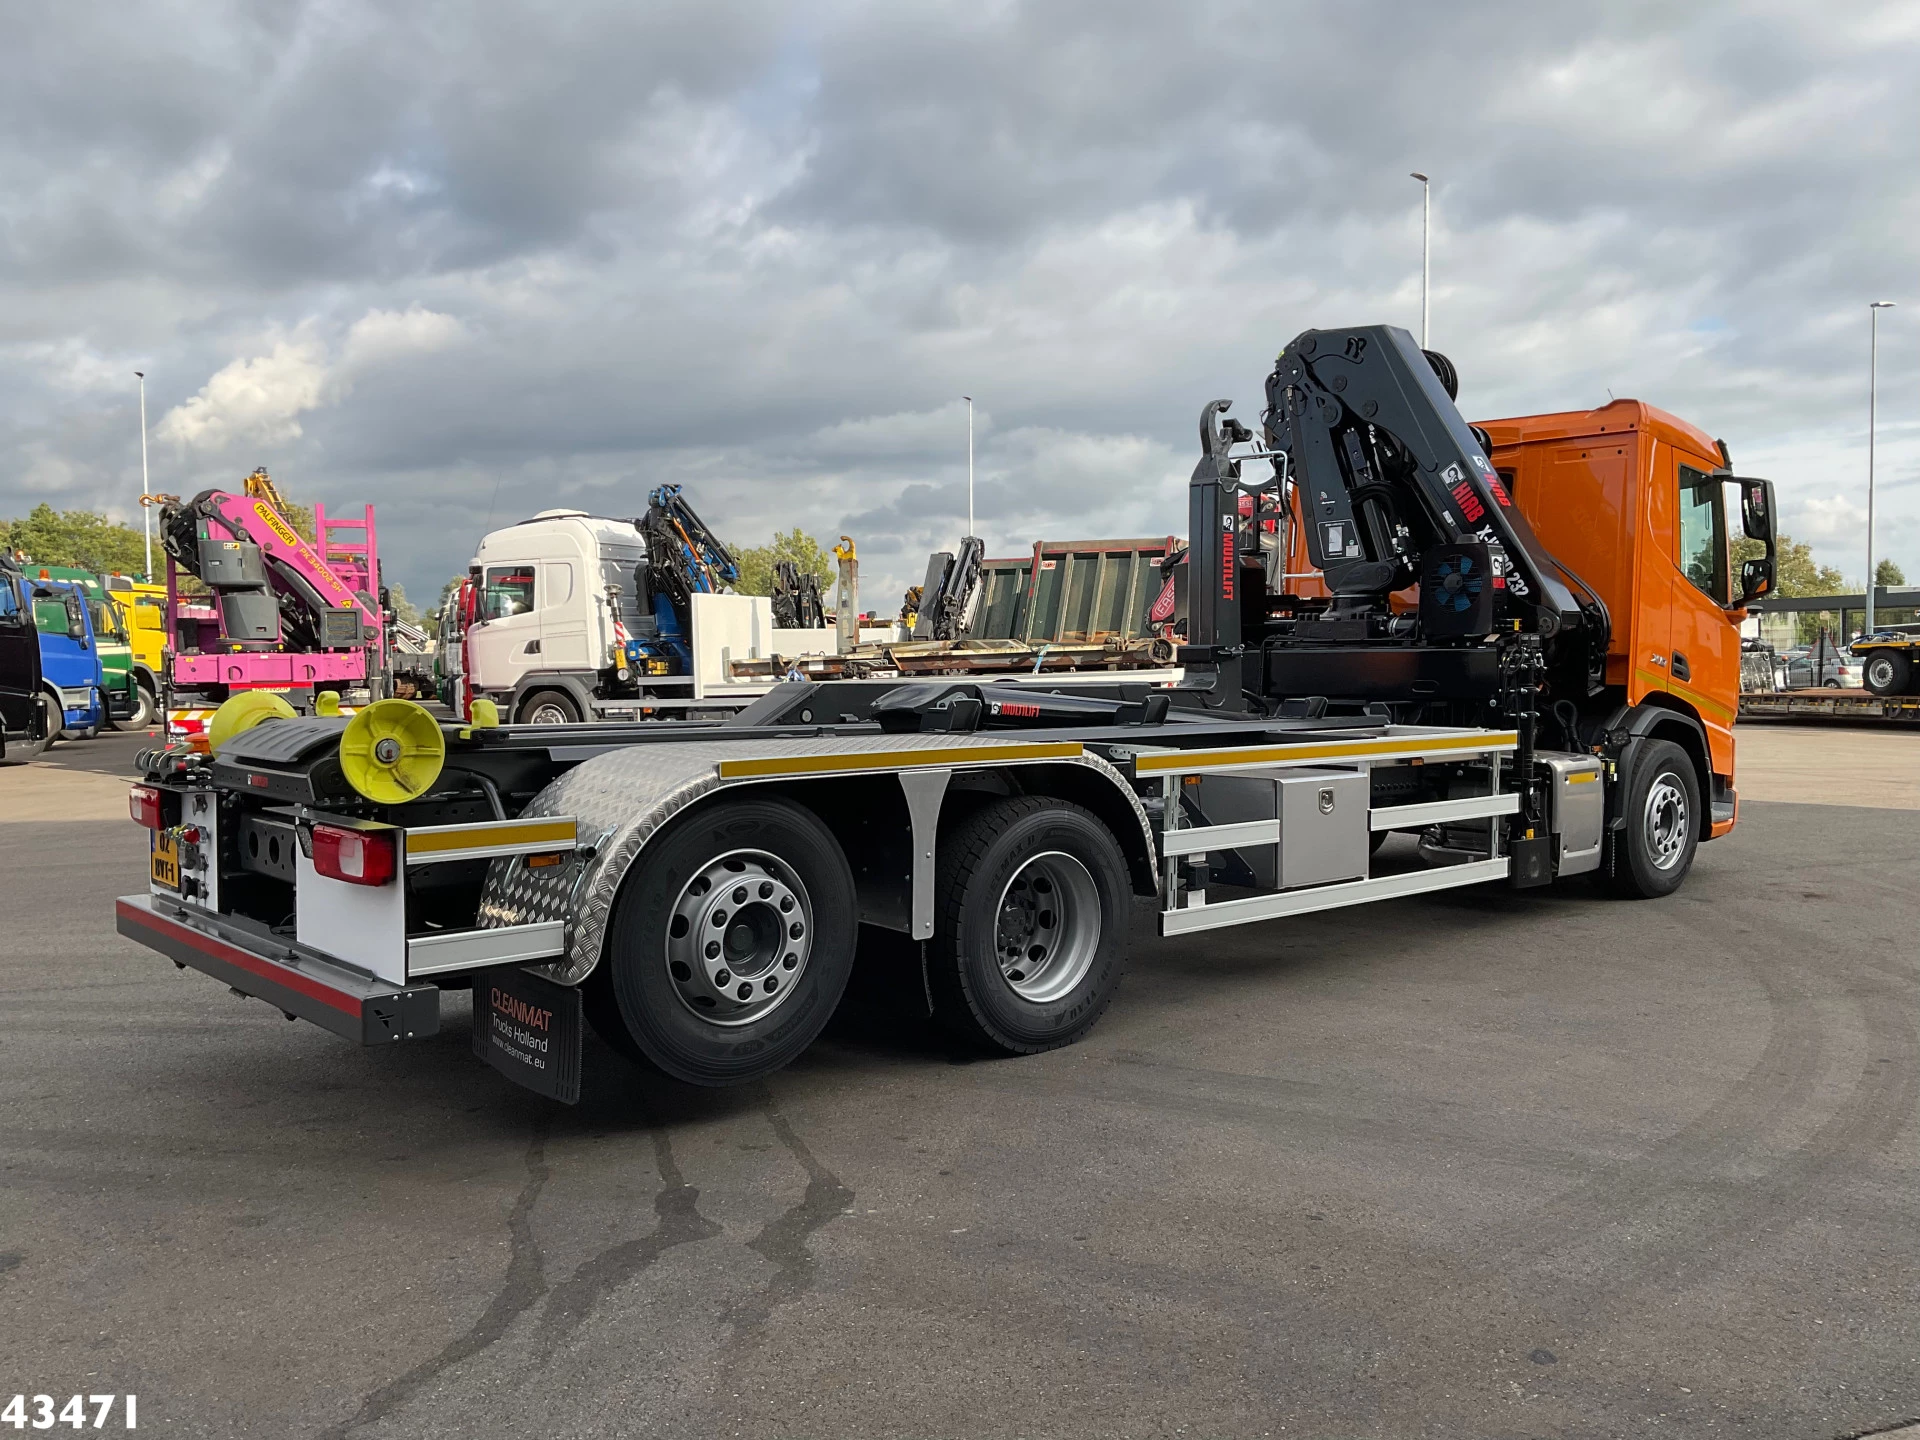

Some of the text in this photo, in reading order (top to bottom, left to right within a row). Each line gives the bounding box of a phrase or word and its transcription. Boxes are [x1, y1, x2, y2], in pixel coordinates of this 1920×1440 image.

[1451, 481, 1485, 523] HIAB
[256, 504, 295, 545] PALFINGER
[1222, 532, 1235, 601] MULTILIFT
[1506, 572, 1530, 596] 232
[1001, 702, 1041, 718] MULTILIFT
[491, 987, 553, 1032] CLEANMAT
[492, 1012, 549, 1053] Trucks Holland
